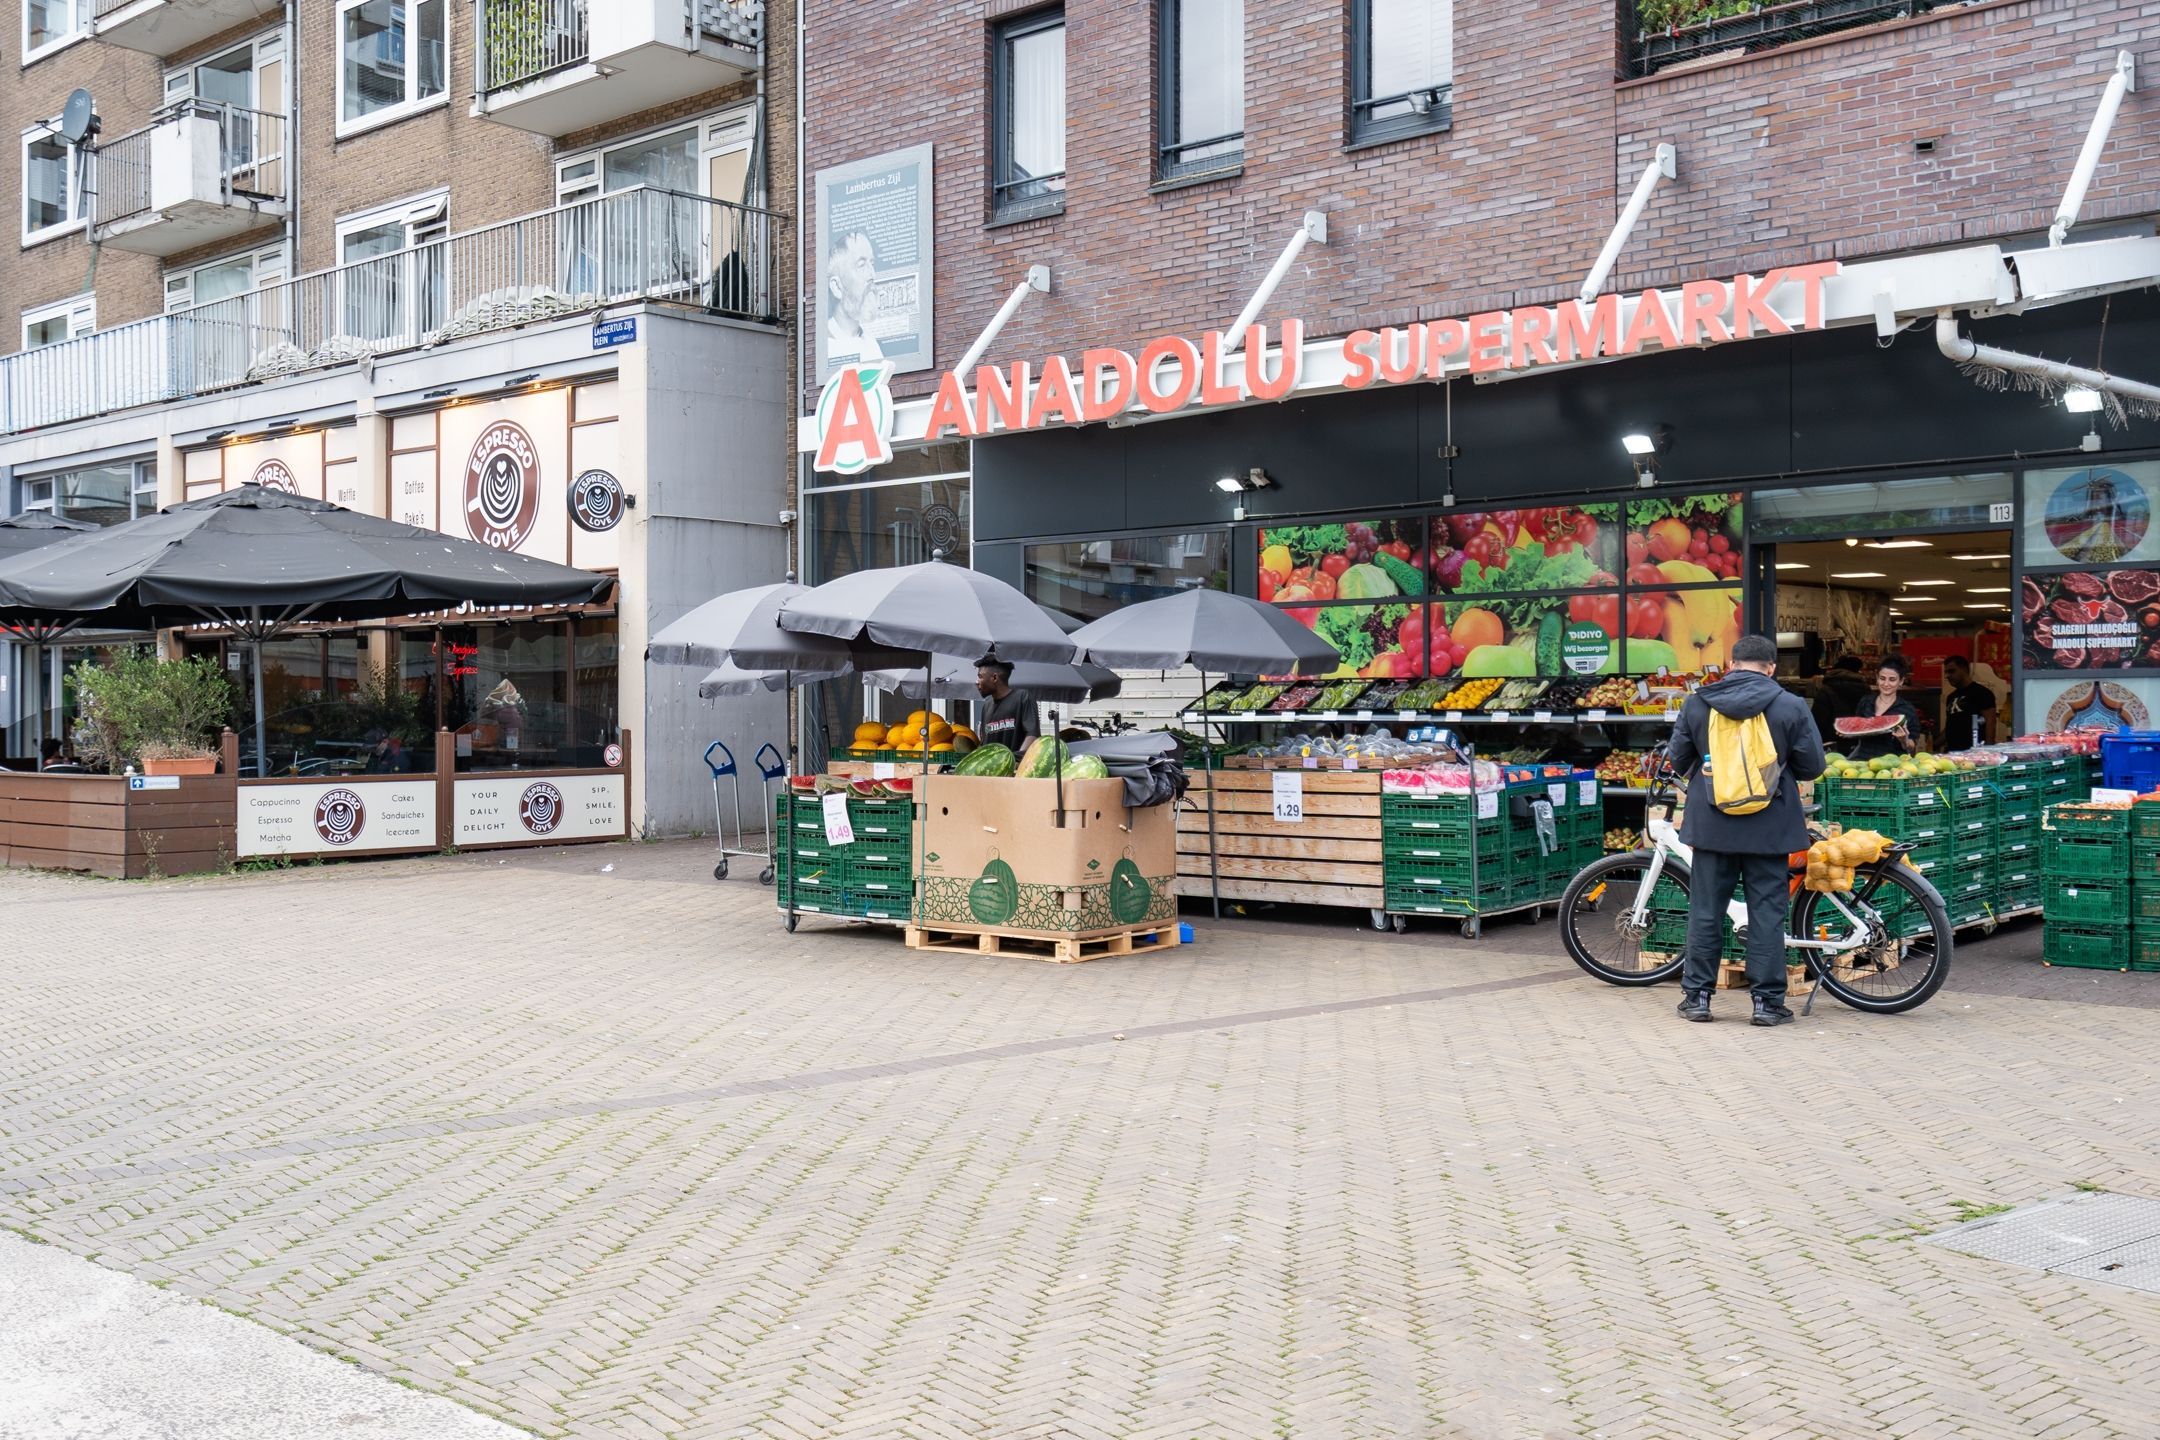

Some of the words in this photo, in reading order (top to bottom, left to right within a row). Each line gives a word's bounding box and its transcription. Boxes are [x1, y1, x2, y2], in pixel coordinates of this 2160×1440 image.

[846, 177, 885, 195] Lambertus
[887, 171, 901, 185] Zijl
[593, 321, 623, 337] LAMBERTUS
[593, 335, 609, 346] PLEIN
[924, 318, 1303, 440] ANADOLU
[1342, 261, 1842, 389] SUPERMARKT
[818, 368, 882, 467] A
[471, 428, 533, 475] ESPRESSO
[404, 480, 425, 495] Coffee
[578, 475, 617, 495] ESPRESSO
[338, 488, 356, 502] Waffle
[1993, 505, 2010, 521] 113
[589, 516, 612, 527] LOVE
[483, 523, 520, 549] LOVE
[2051, 624, 2086, 635] SLAGERIJ
[1564, 645, 1577, 654] Wij
[1577, 644, 1608, 653] bezorgen
[2052, 638, 2086, 649] ANADOLU
[2086, 637, 2137, 648] SUPERMARKT
[391, 794, 415, 803] Cakes
[523, 785, 560, 803] ESPRESSO
[319, 791, 361, 811] ESPRESSO
[381, 811, 425, 820] Sandwiches
[470, 807, 499, 816] DAILY
[1276, 803, 1300, 817] 1.29
[257, 816, 293, 826] Espresso
[531, 822, 553, 832] LOVE
[589, 817, 613, 825] LOVE
[385, 828, 421, 837] Icecream
[463, 823, 505, 832] DELIGHT
[828, 824, 851, 840] 1.49
[259, 834, 292, 843] Matcha
[327, 832, 353, 843] LOVE
